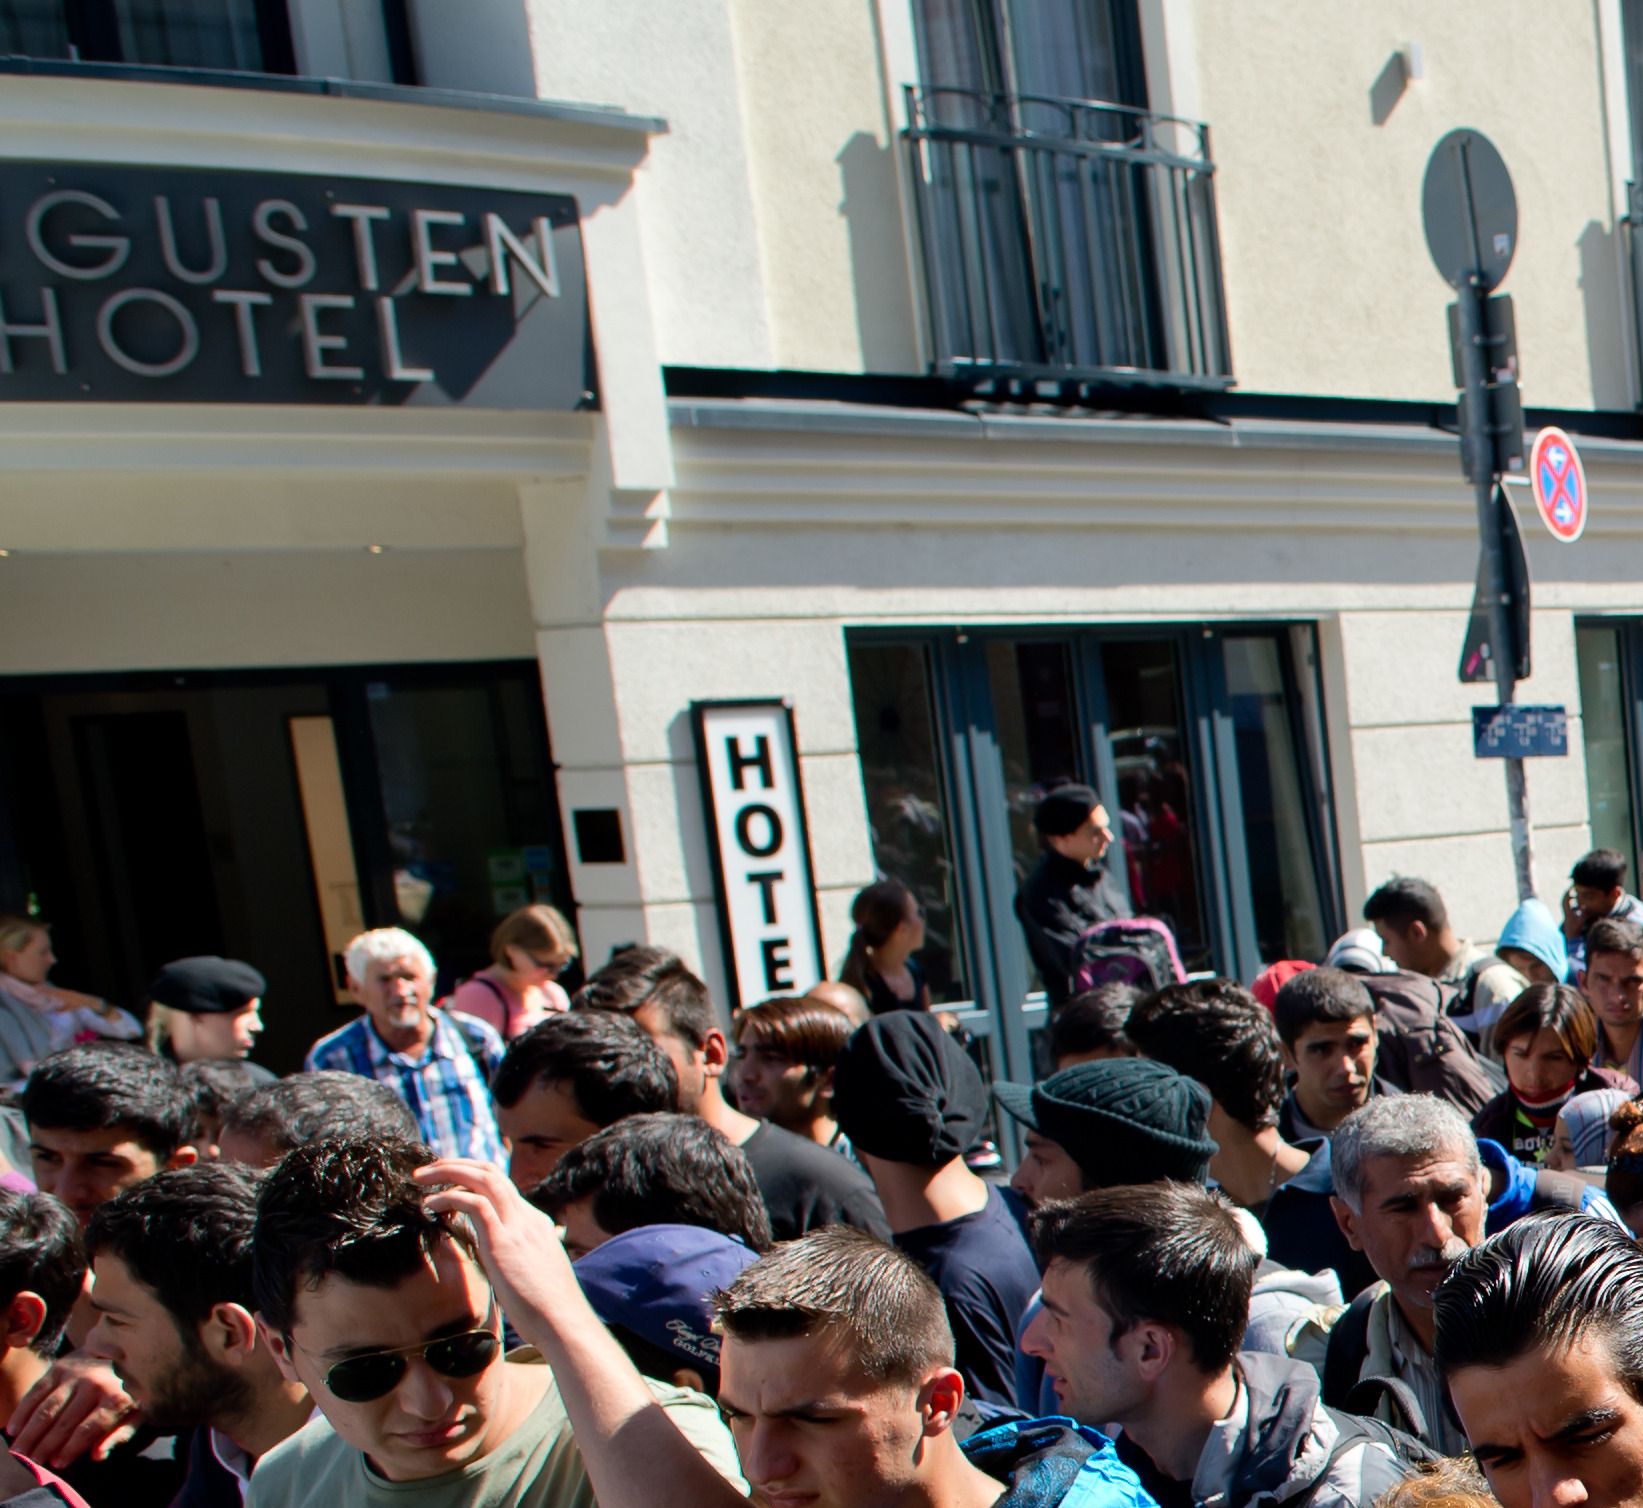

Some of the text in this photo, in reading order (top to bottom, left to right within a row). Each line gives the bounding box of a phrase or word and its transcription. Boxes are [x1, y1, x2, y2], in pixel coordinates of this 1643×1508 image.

[26, 188, 560, 298] GUSTEN
[0, 285, 436, 383] HOTEL
[725, 733, 795, 993] HOTE
